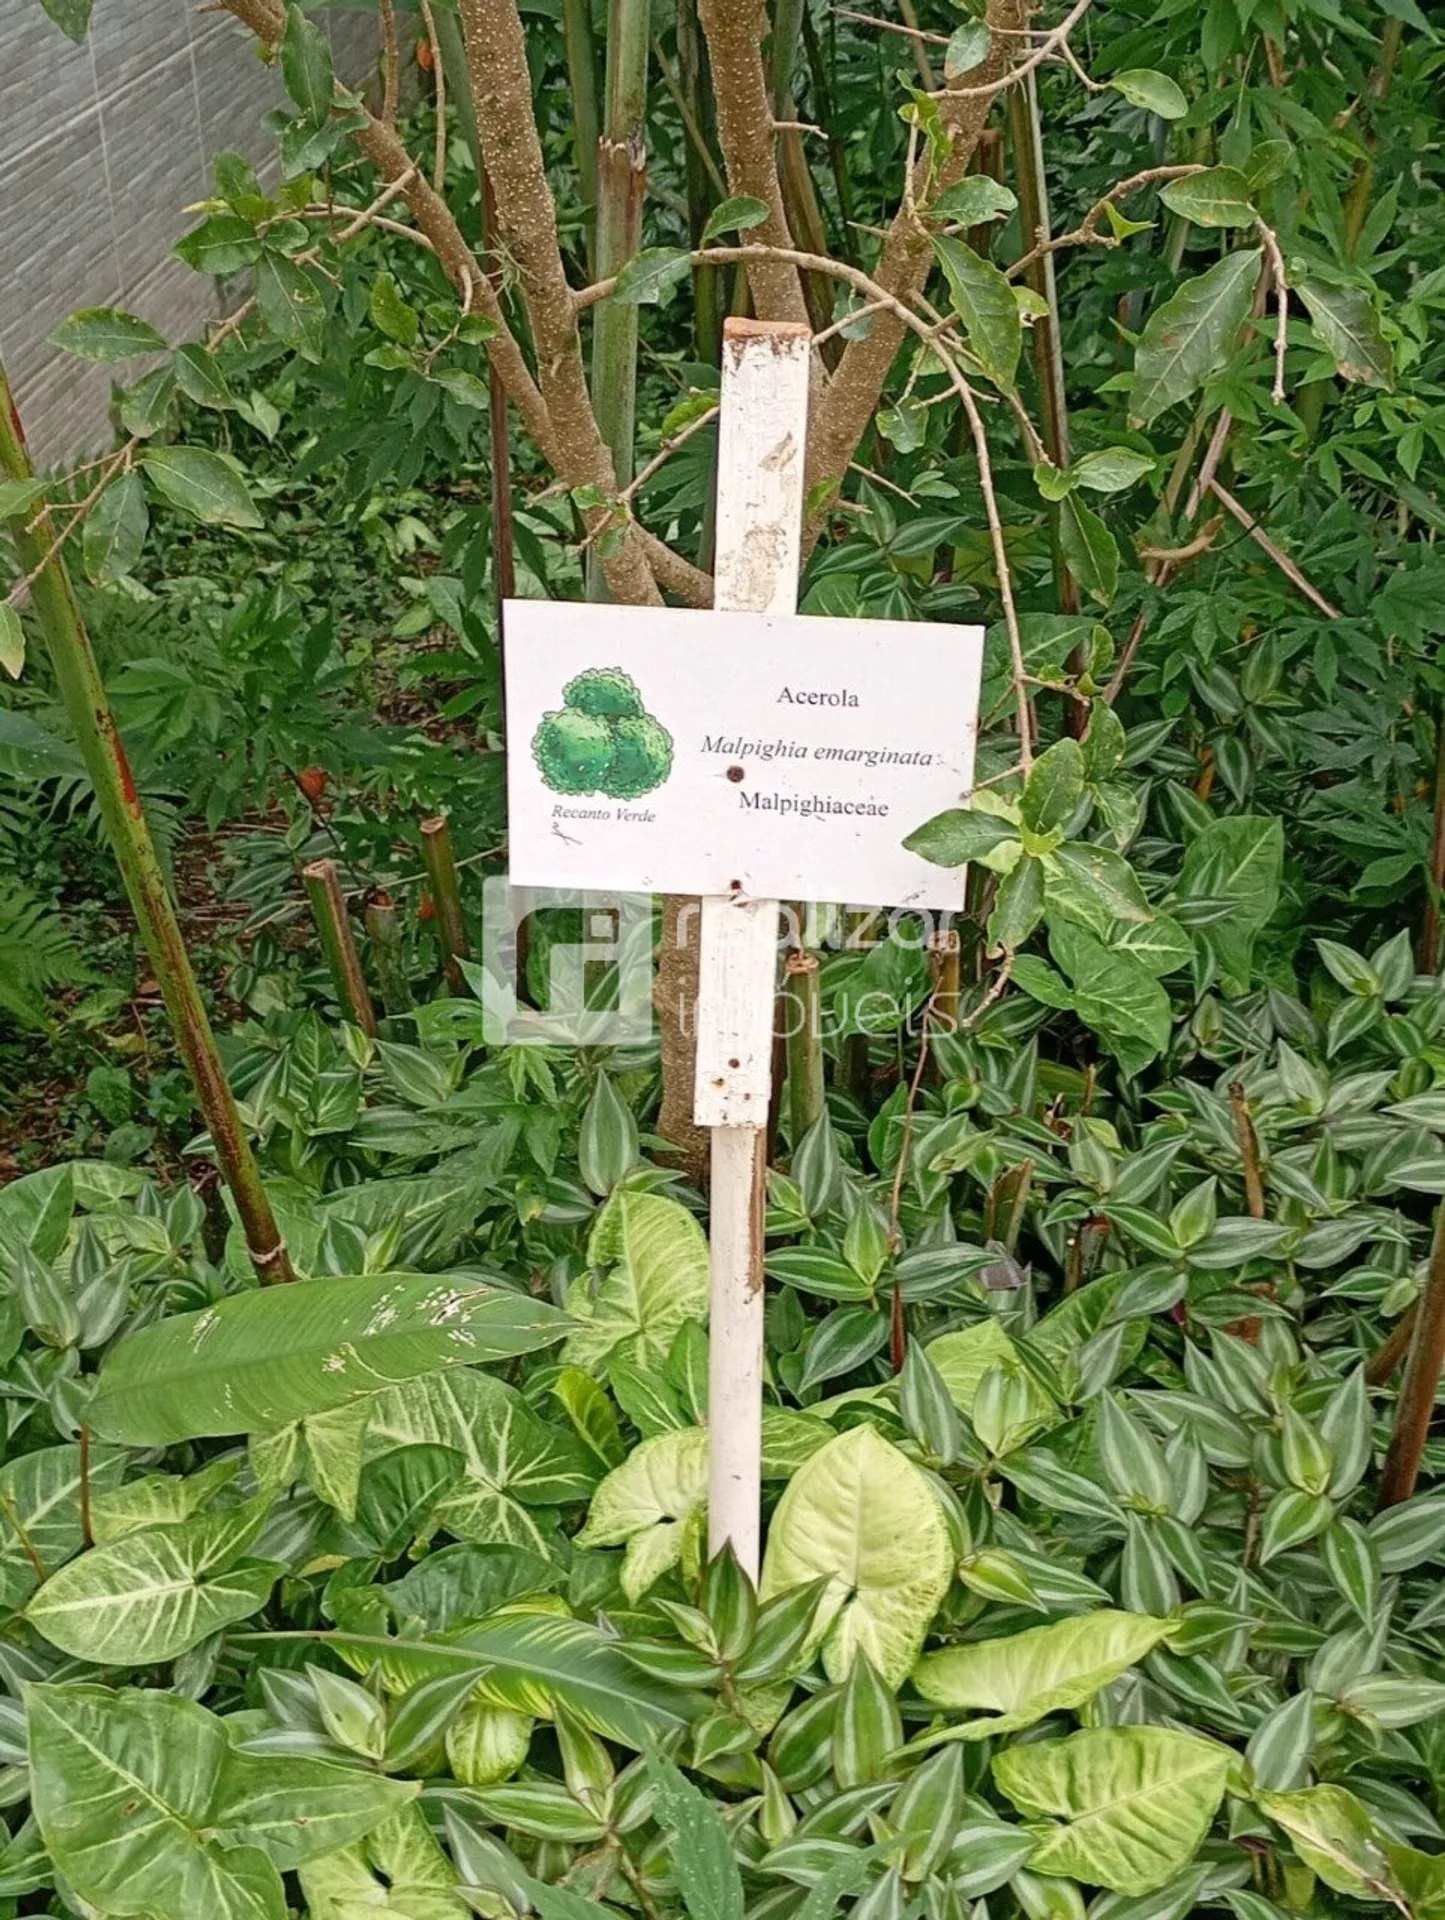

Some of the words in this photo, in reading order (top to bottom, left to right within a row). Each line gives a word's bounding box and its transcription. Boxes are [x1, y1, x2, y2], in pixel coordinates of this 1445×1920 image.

[776, 686, 860, 708] Acerola
[700, 735, 808, 762] Malpighia
[813, 746, 934, 767] emarginata
[551, 804, 611, 821] Recanto
[616, 808, 656, 823] Verde
[739, 791, 890, 817] Malpighiaceae
